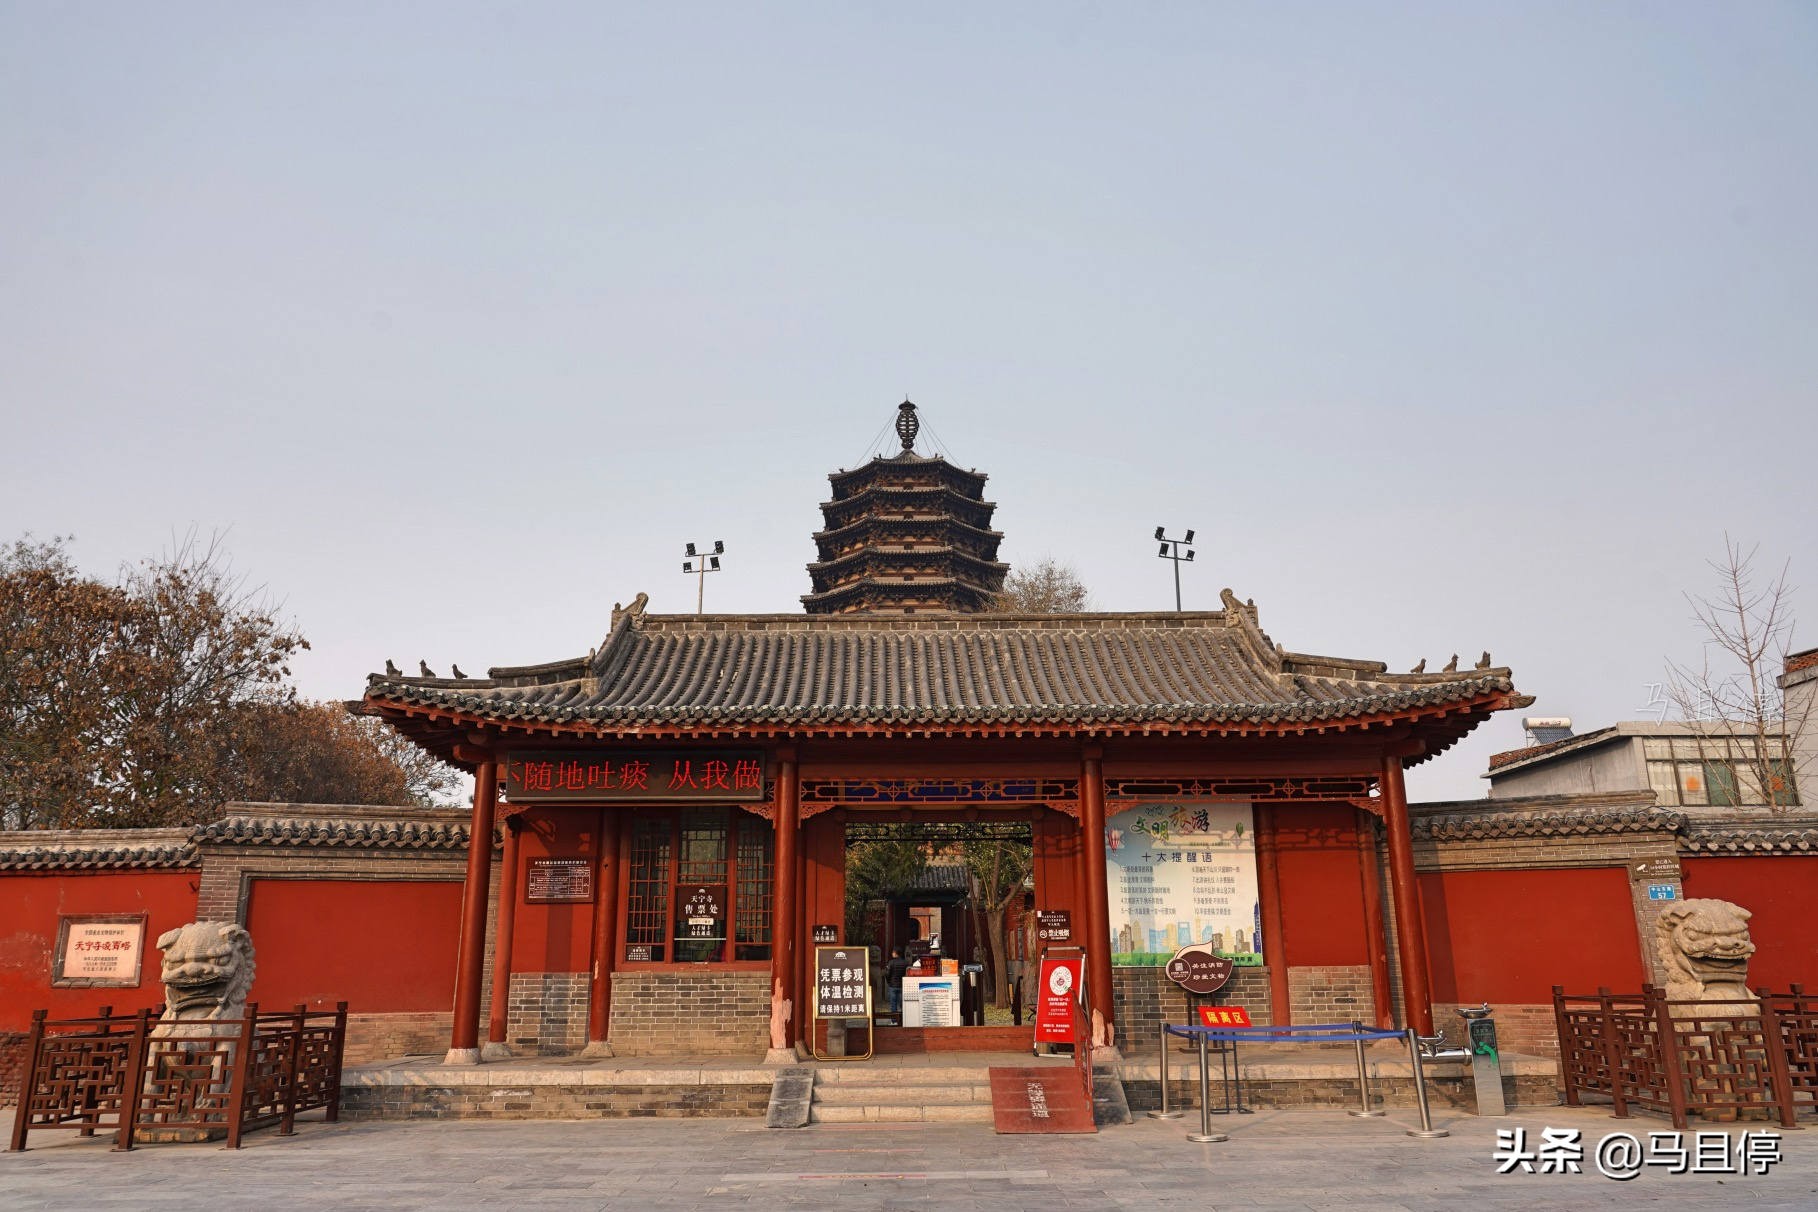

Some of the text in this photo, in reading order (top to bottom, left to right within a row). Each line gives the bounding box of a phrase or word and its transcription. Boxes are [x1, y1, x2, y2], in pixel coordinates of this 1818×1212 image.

[667, 760, 762, 791] 从我做
[1130, 806, 1210, 842] 文明旅游
[1141, 852, 1213, 863] 十大提醒语
[690, 895, 713, 903] 天宁寺
[685, 904, 718, 914] 售票处
[820, 968, 864, 982] 凭票参观
[820, 985, 864, 999] 体温检测
[820, 1004, 865, 1014] 请保持1米距离
[1206, 1011, 1245, 1024] 隔离区
